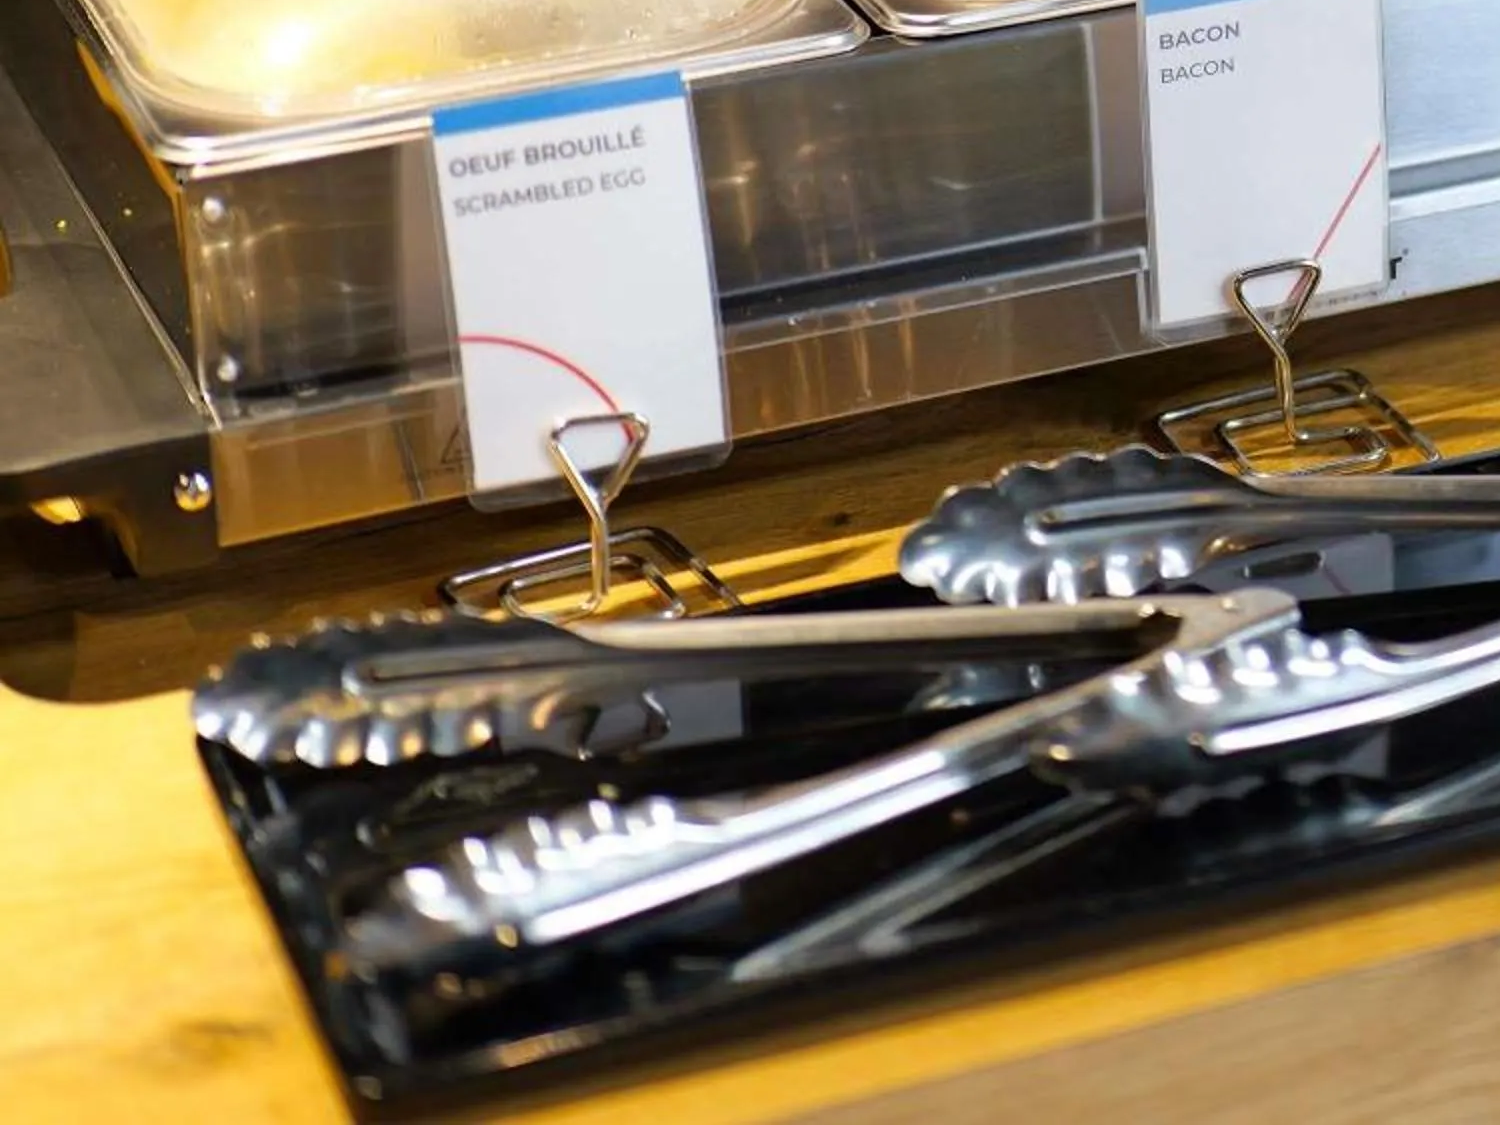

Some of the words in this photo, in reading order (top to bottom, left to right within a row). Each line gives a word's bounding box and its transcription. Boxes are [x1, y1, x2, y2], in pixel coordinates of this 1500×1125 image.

[1159, 21, 1240, 50] BACON
[1161, 58, 1234, 84] BACON
[449, 150, 517, 178] OEUF
[524, 125, 646, 166] BROUILLÉ
[453, 177, 594, 216] SCRAMBLED
[600, 168, 646, 192] EGG
